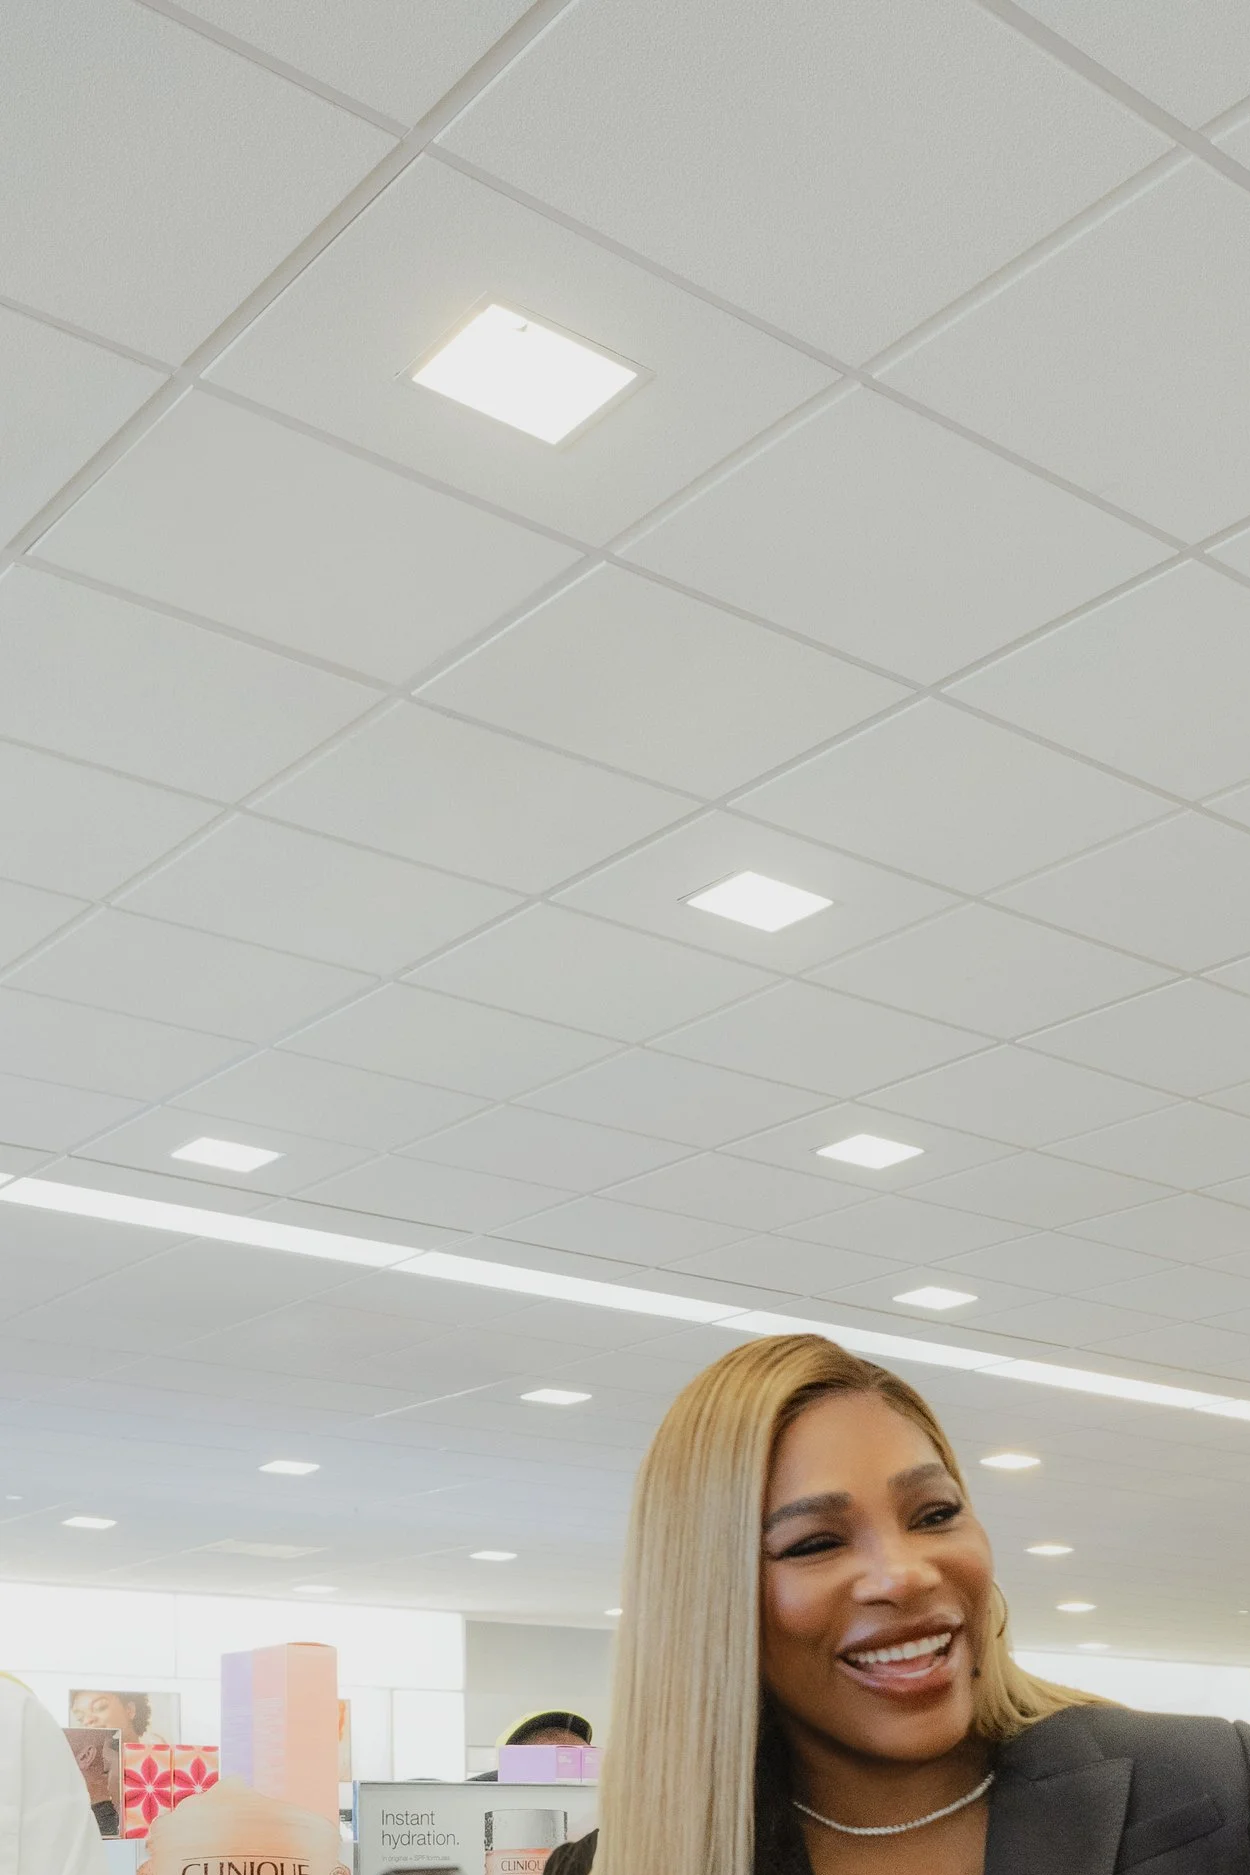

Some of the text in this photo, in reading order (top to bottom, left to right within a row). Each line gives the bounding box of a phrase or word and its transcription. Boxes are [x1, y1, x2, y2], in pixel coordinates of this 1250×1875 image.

[381, 1809, 436, 1826] Instant
[381, 1829, 460, 1850] hydration.
[501, 1859, 547, 1872] CLINIQU
